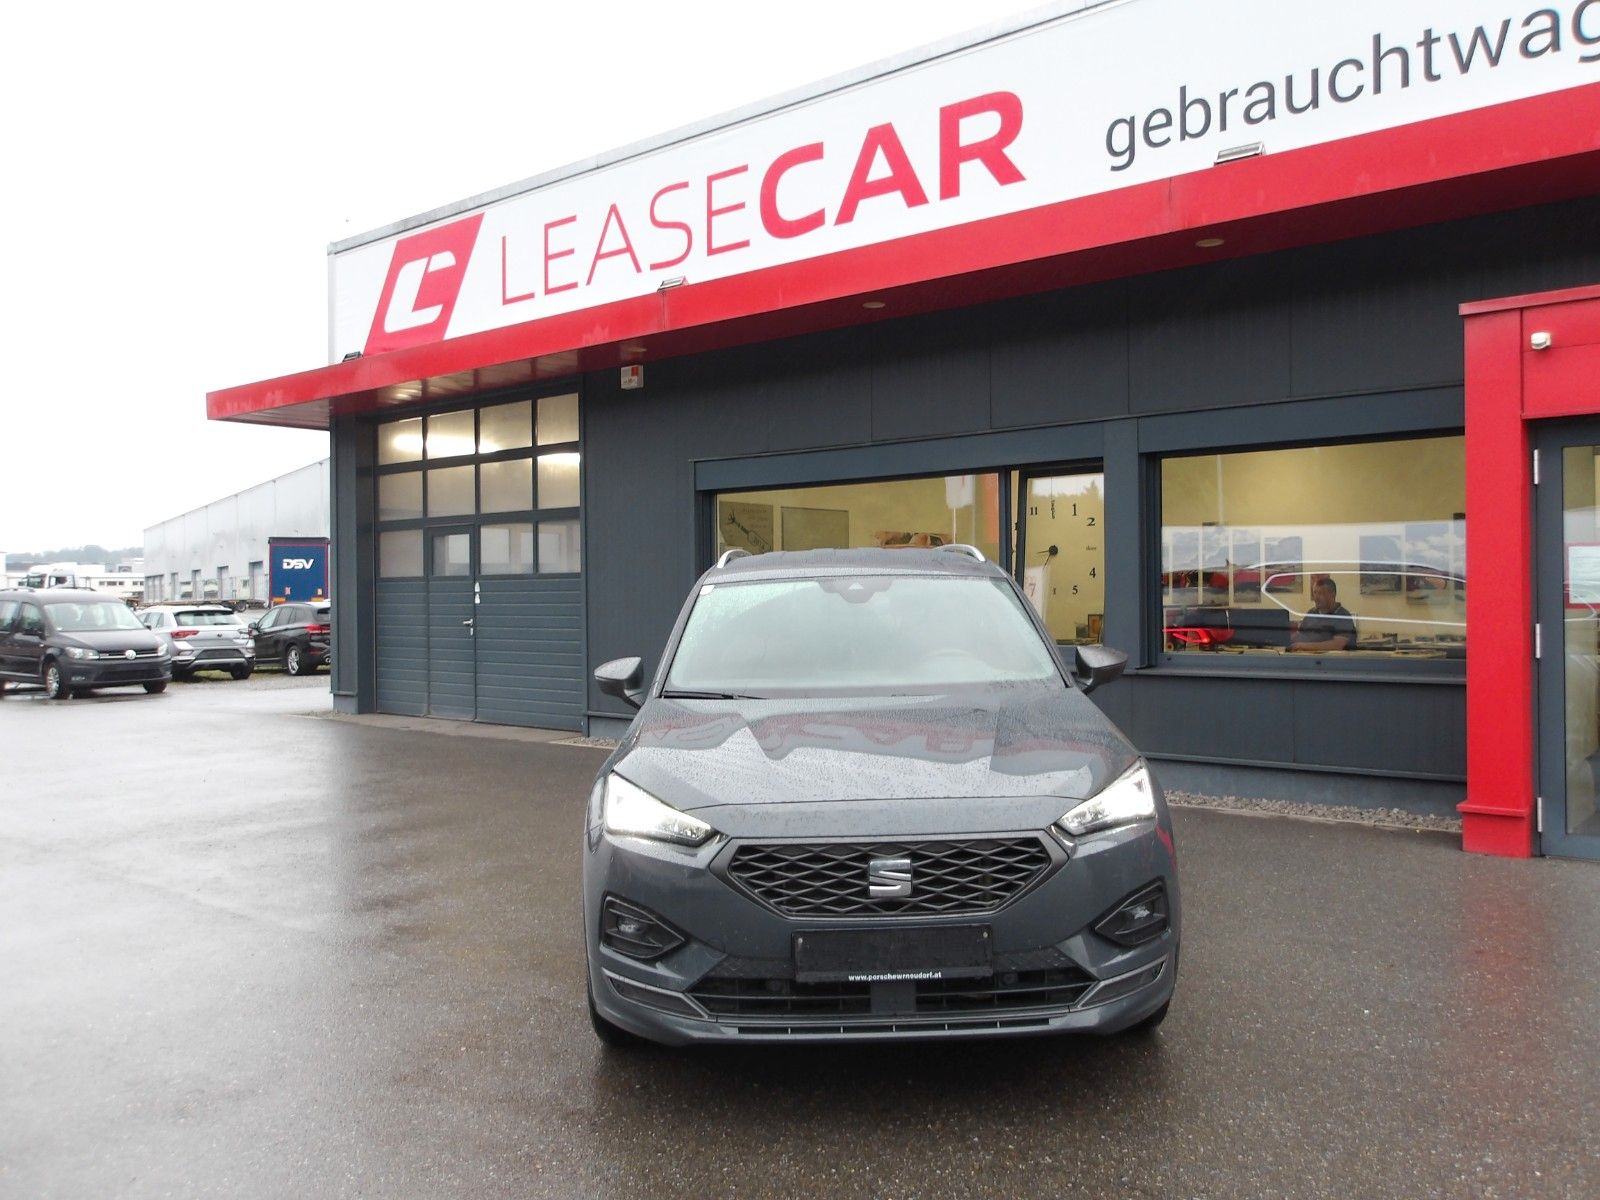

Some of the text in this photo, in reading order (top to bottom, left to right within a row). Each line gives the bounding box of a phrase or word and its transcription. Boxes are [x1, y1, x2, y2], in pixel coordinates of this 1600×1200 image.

[1072, 503, 1077, 516] 1
[1087, 517, 1095, 526] 2
[282, 558, 314, 569] DSV
[1089, 567, 1096, 578] 4
[1071, 585, 1079, 596] 5
